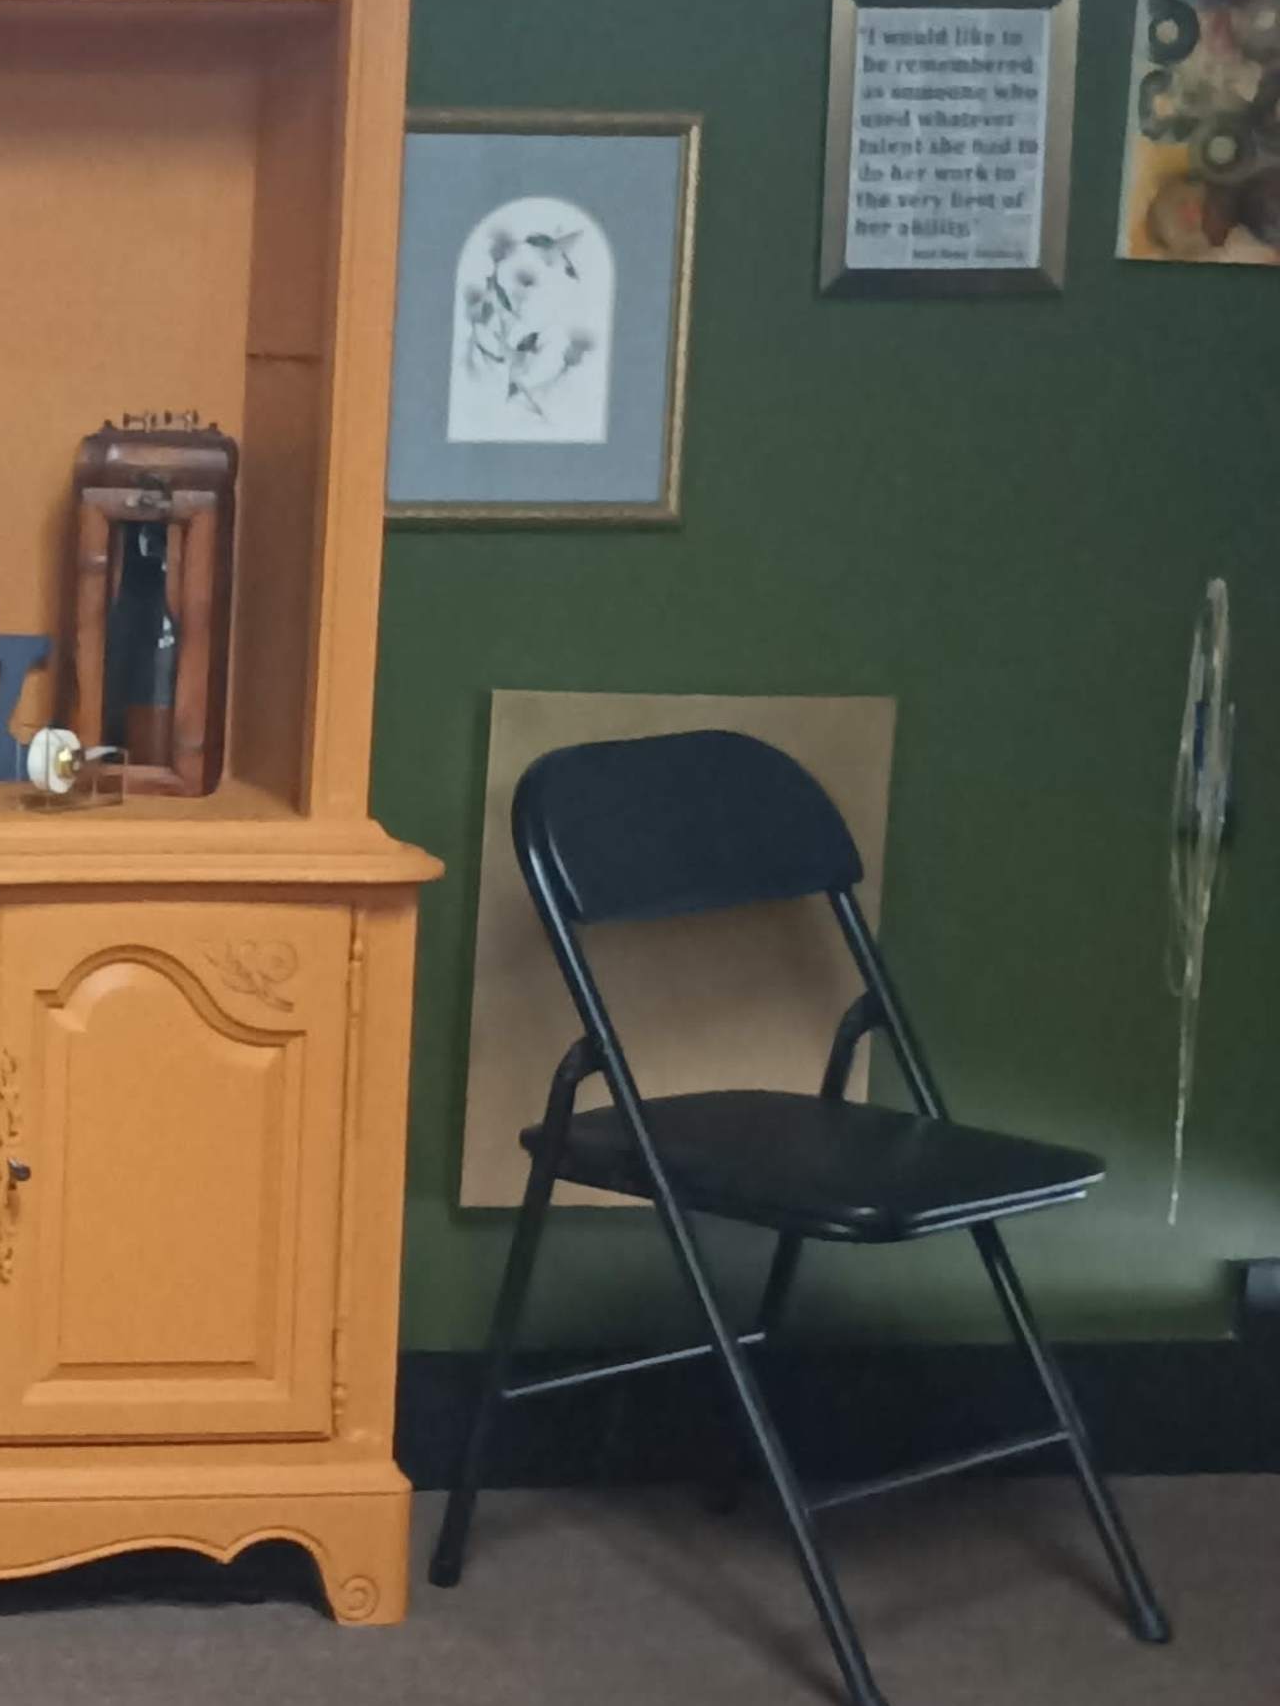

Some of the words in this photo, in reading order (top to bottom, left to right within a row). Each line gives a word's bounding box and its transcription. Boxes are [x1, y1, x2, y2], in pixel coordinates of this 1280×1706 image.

[883, 26, 948, 45] would
[955, 26, 995, 45] like
[1002, 30, 1024, 46] to
[863, 55, 889, 73] be
[895, 55, 1033, 74] remembered
[891, 86, 987, 100] someone
[994, 83, 1038, 99] who
[918, 110, 1015, 127] whatever
[858, 138, 923, 155] talent
[890, 164, 927, 182] her
[935, 163, 988, 182] work
[856, 191, 890, 209] the
[898, 194, 942, 213] very
[951, 191, 995, 209] best
[1002, 191, 1024, 209] of
[855, 219, 891, 237] her
